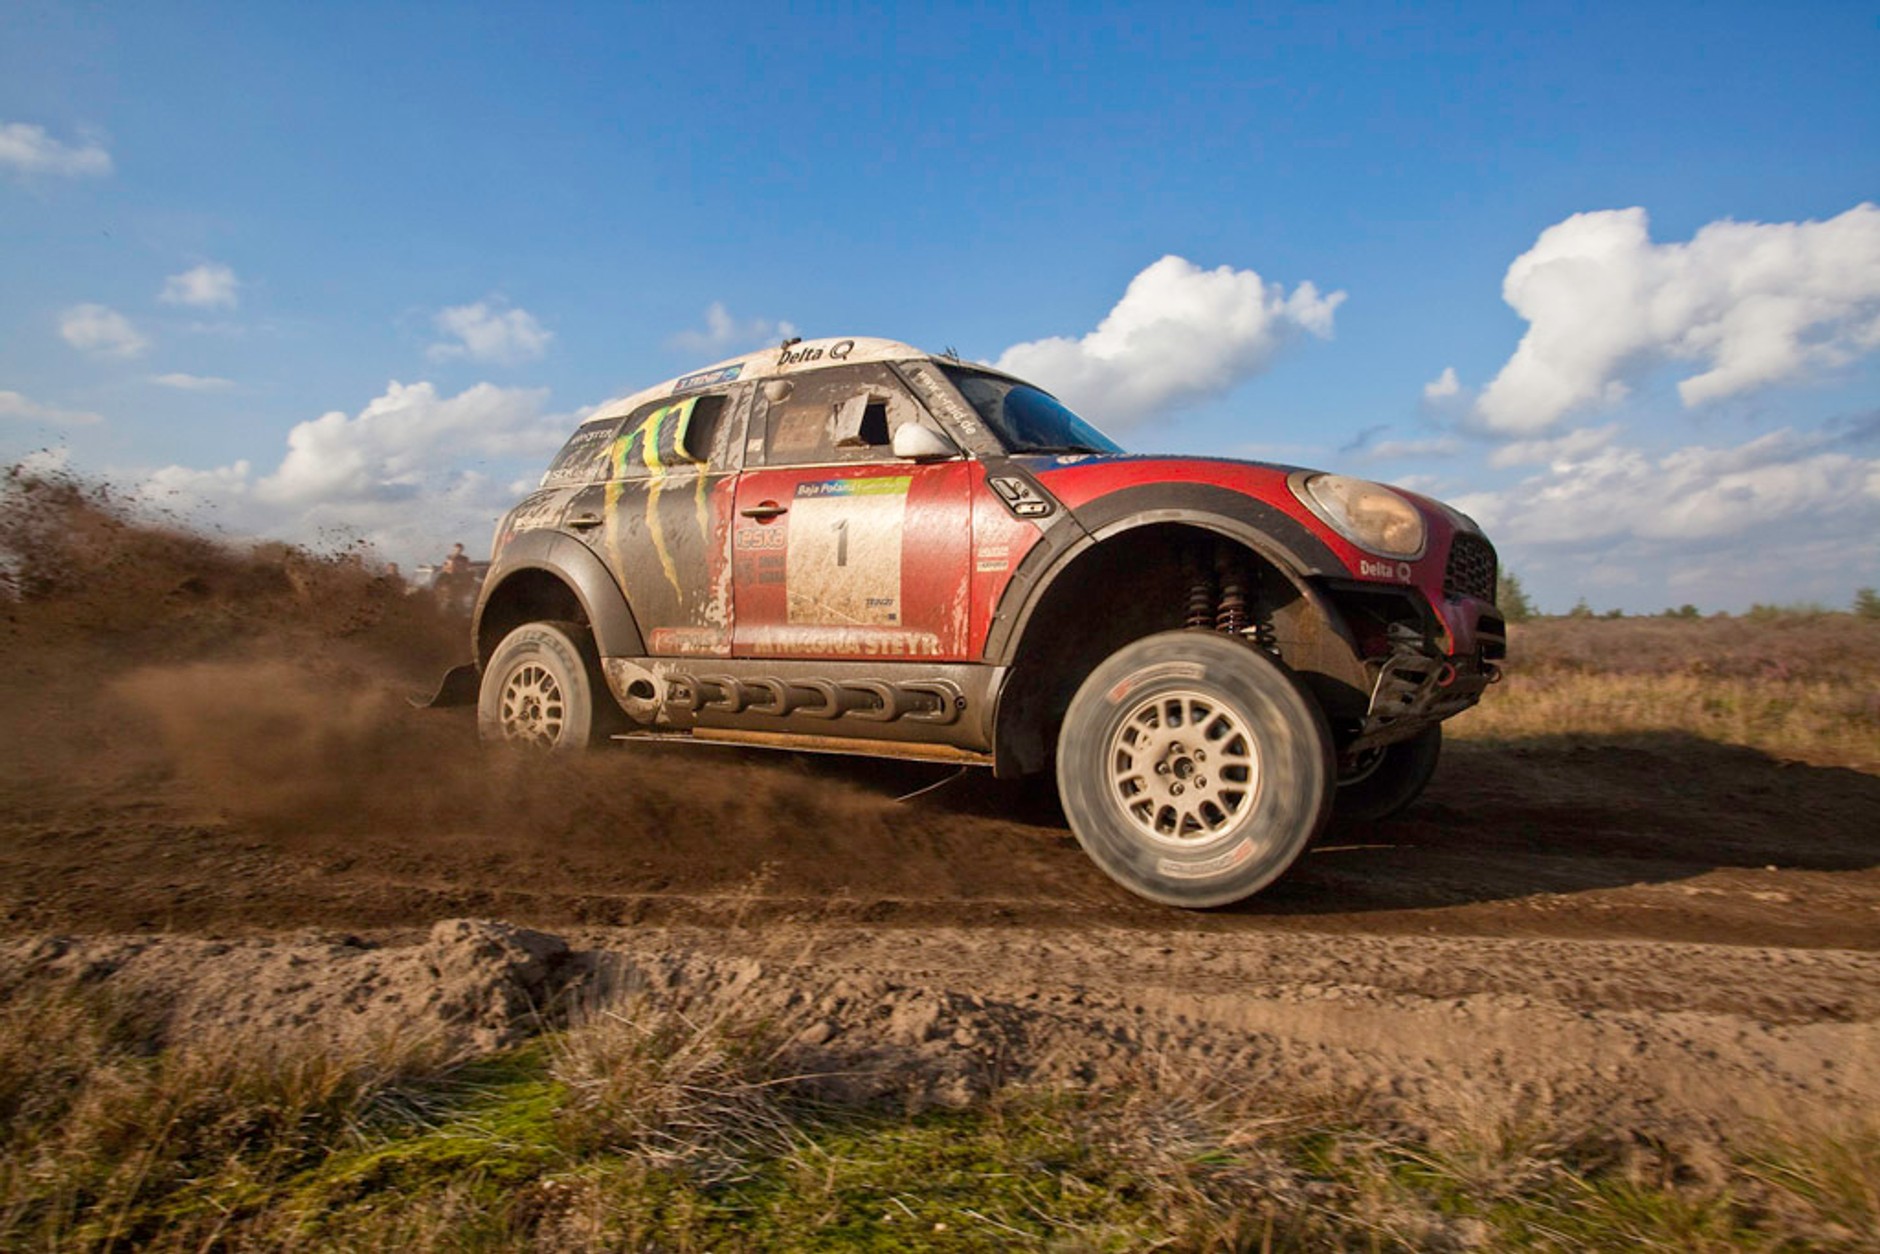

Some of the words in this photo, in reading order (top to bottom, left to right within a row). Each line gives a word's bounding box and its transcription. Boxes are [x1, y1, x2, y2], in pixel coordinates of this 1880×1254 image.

[777, 346, 824, 367] Delta
[828, 340, 855, 361] Q
[798, 483, 820, 497] Baja
[831, 518, 849, 567] 1
[1360, 560, 1393, 578] Delta
[1397, 562, 1412, 584] Q
[864, 632, 940, 655] STEYR
